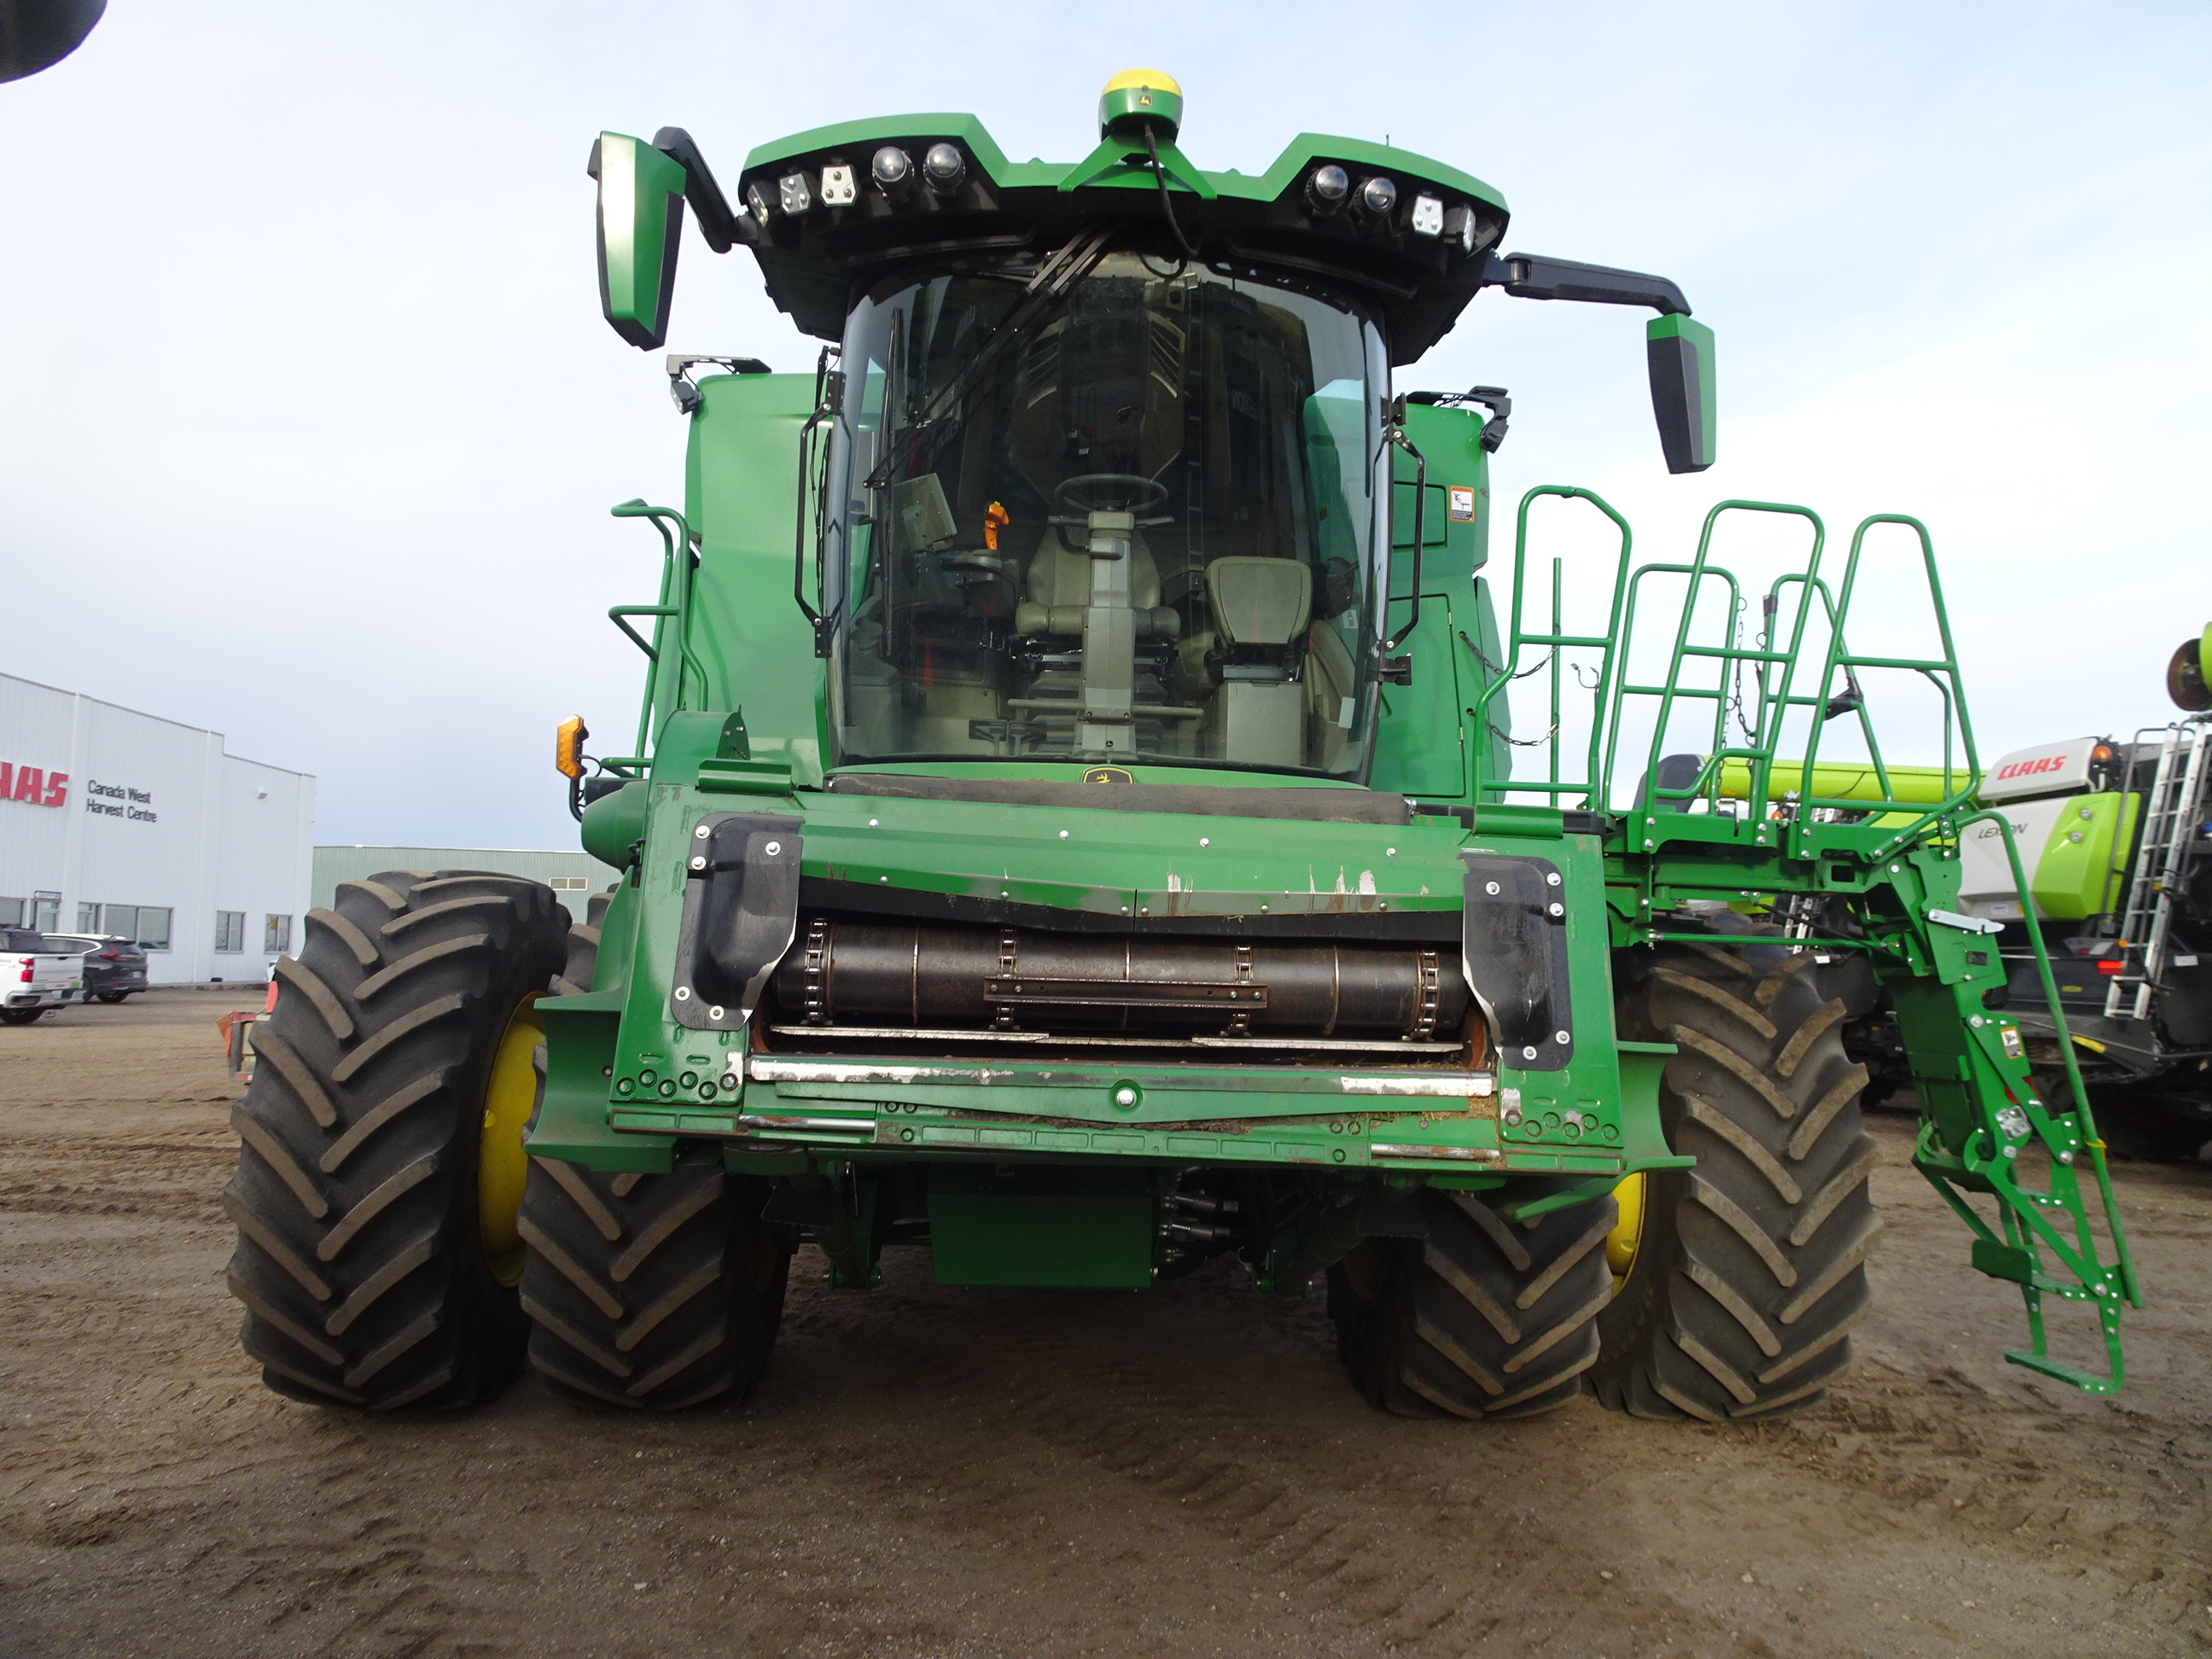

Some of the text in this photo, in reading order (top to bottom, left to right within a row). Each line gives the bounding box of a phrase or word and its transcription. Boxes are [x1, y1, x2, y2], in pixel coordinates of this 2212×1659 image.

[1996, 755, 2069, 780] CLAAS
[88, 780, 151, 804] Canada West
[86, 798, 157, 823] Harvest Centre
[1978, 823, 2029, 839] LEXON
